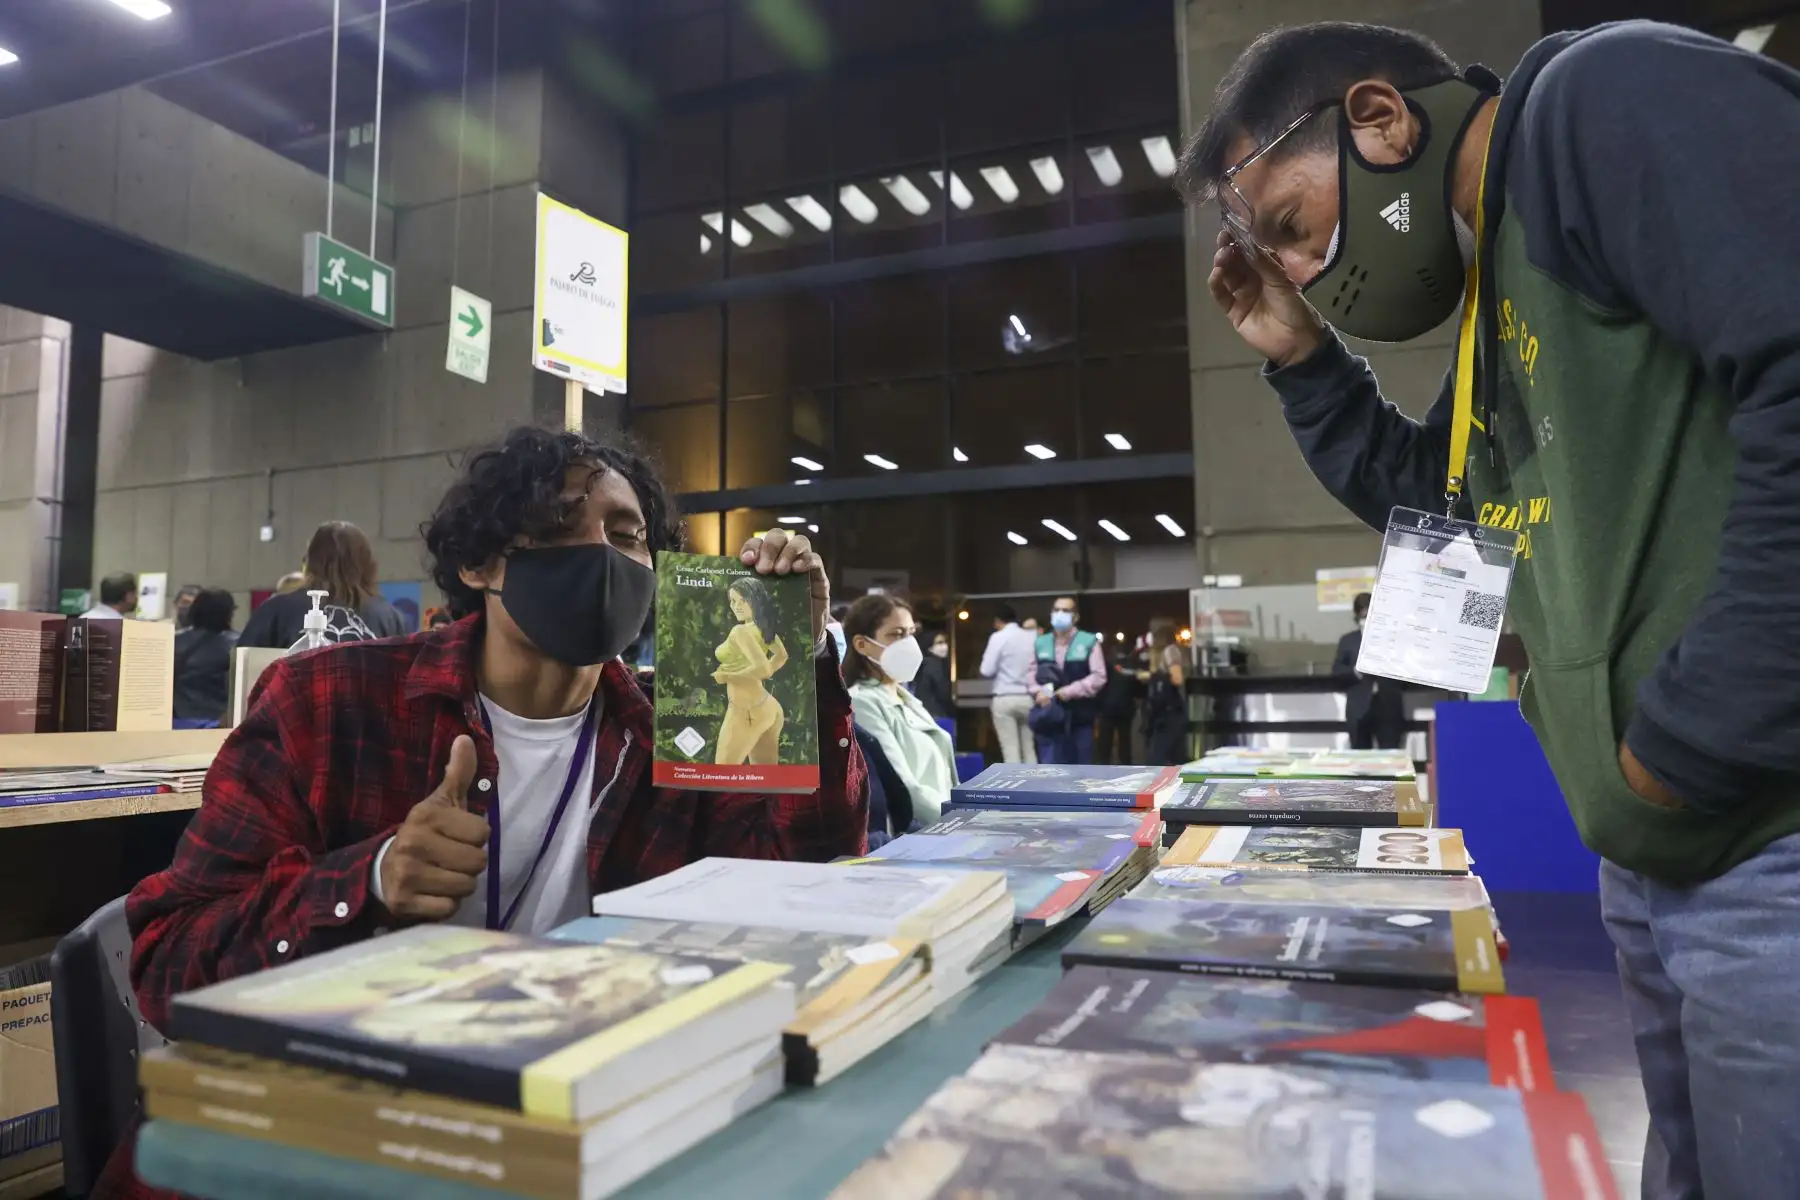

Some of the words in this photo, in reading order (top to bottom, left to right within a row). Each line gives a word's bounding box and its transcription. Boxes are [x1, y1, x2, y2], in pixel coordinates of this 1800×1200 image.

[1400, 192, 1410, 232] adidas
[675, 574, 713, 588] Linda
[1376, 832, 1430, 866] 200
